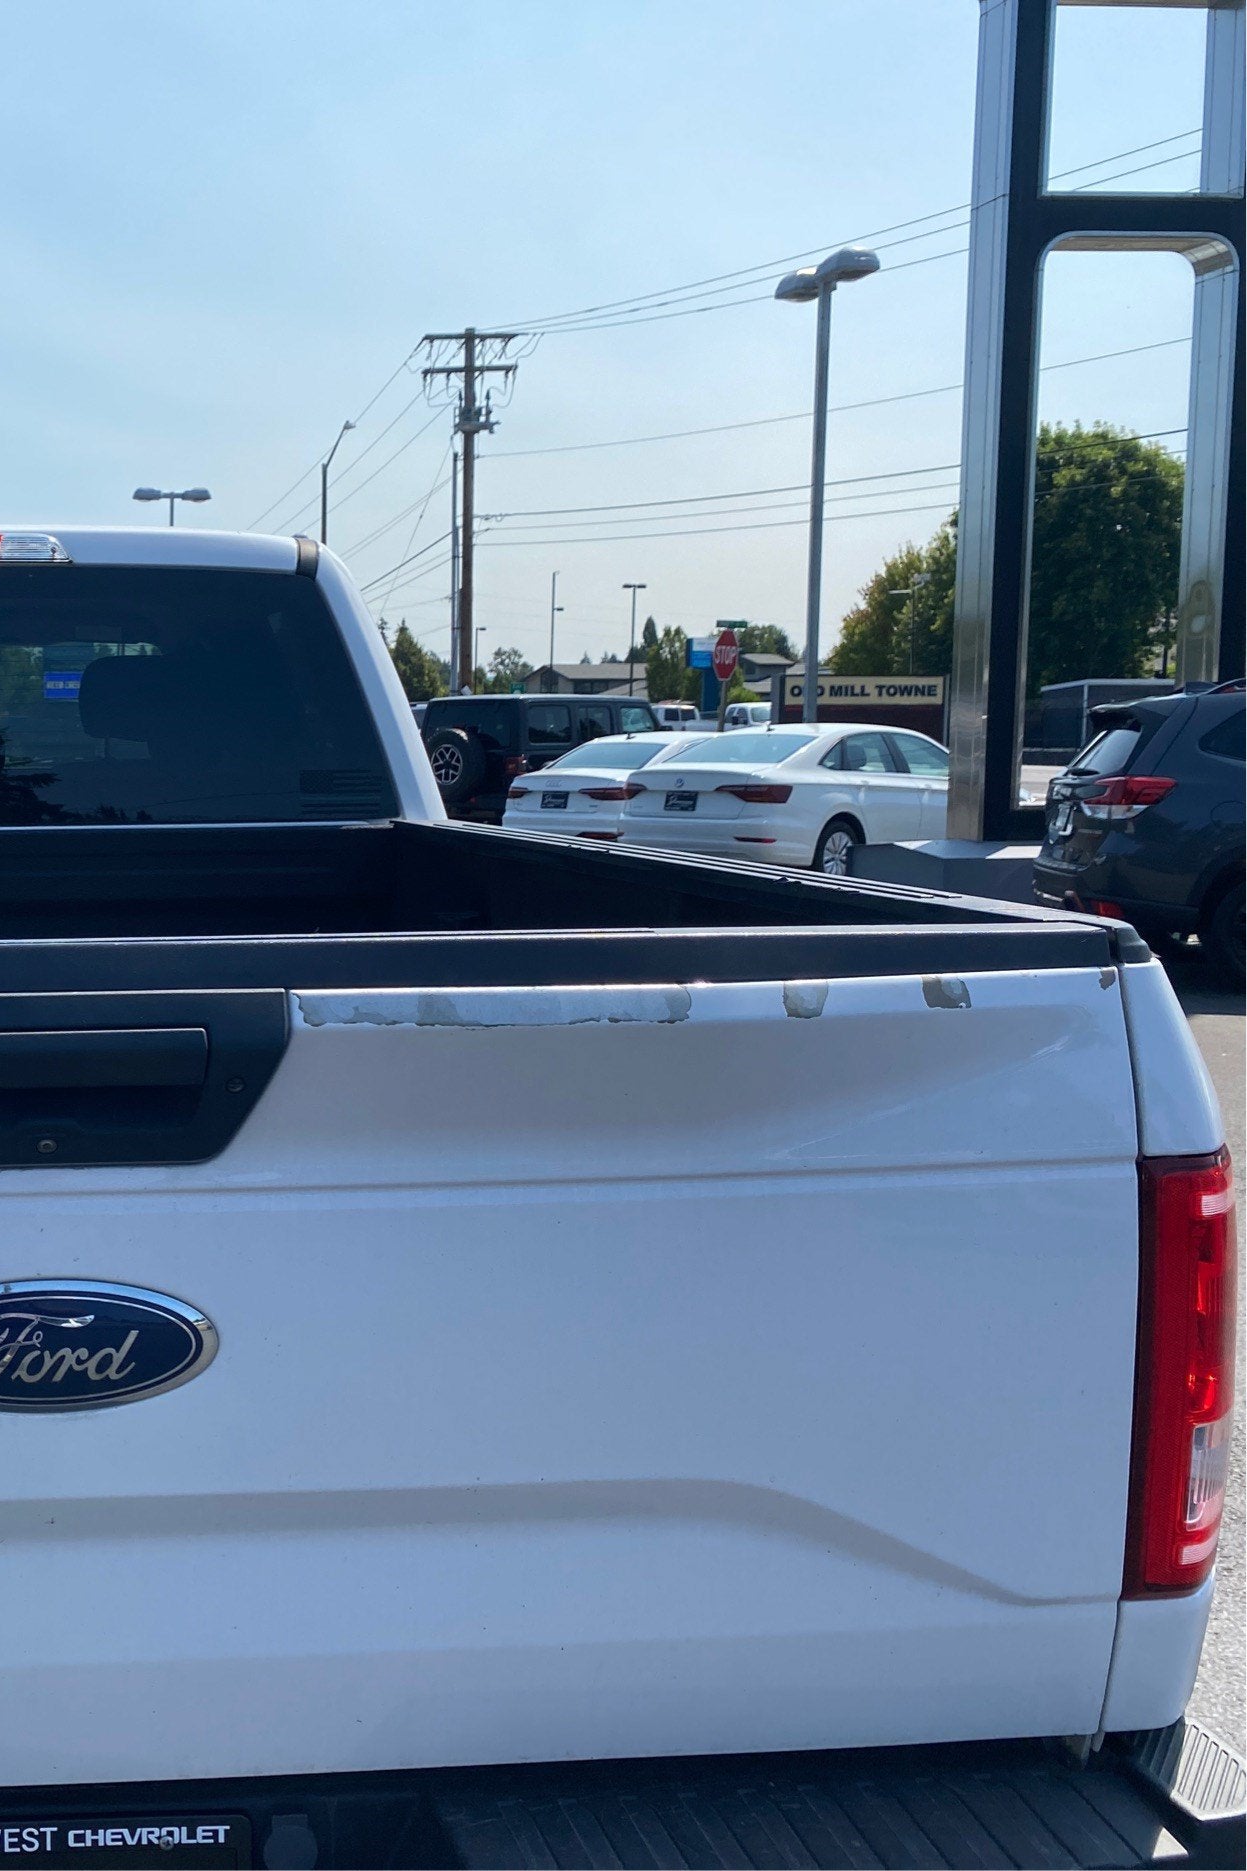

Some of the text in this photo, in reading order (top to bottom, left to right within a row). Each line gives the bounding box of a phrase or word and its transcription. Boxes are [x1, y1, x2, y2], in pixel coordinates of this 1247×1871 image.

[715, 645, 737, 664] STOP
[790, 685, 937, 697] OD MILL TOWNE
[67, 1825, 230, 1848] CHEVROLET
